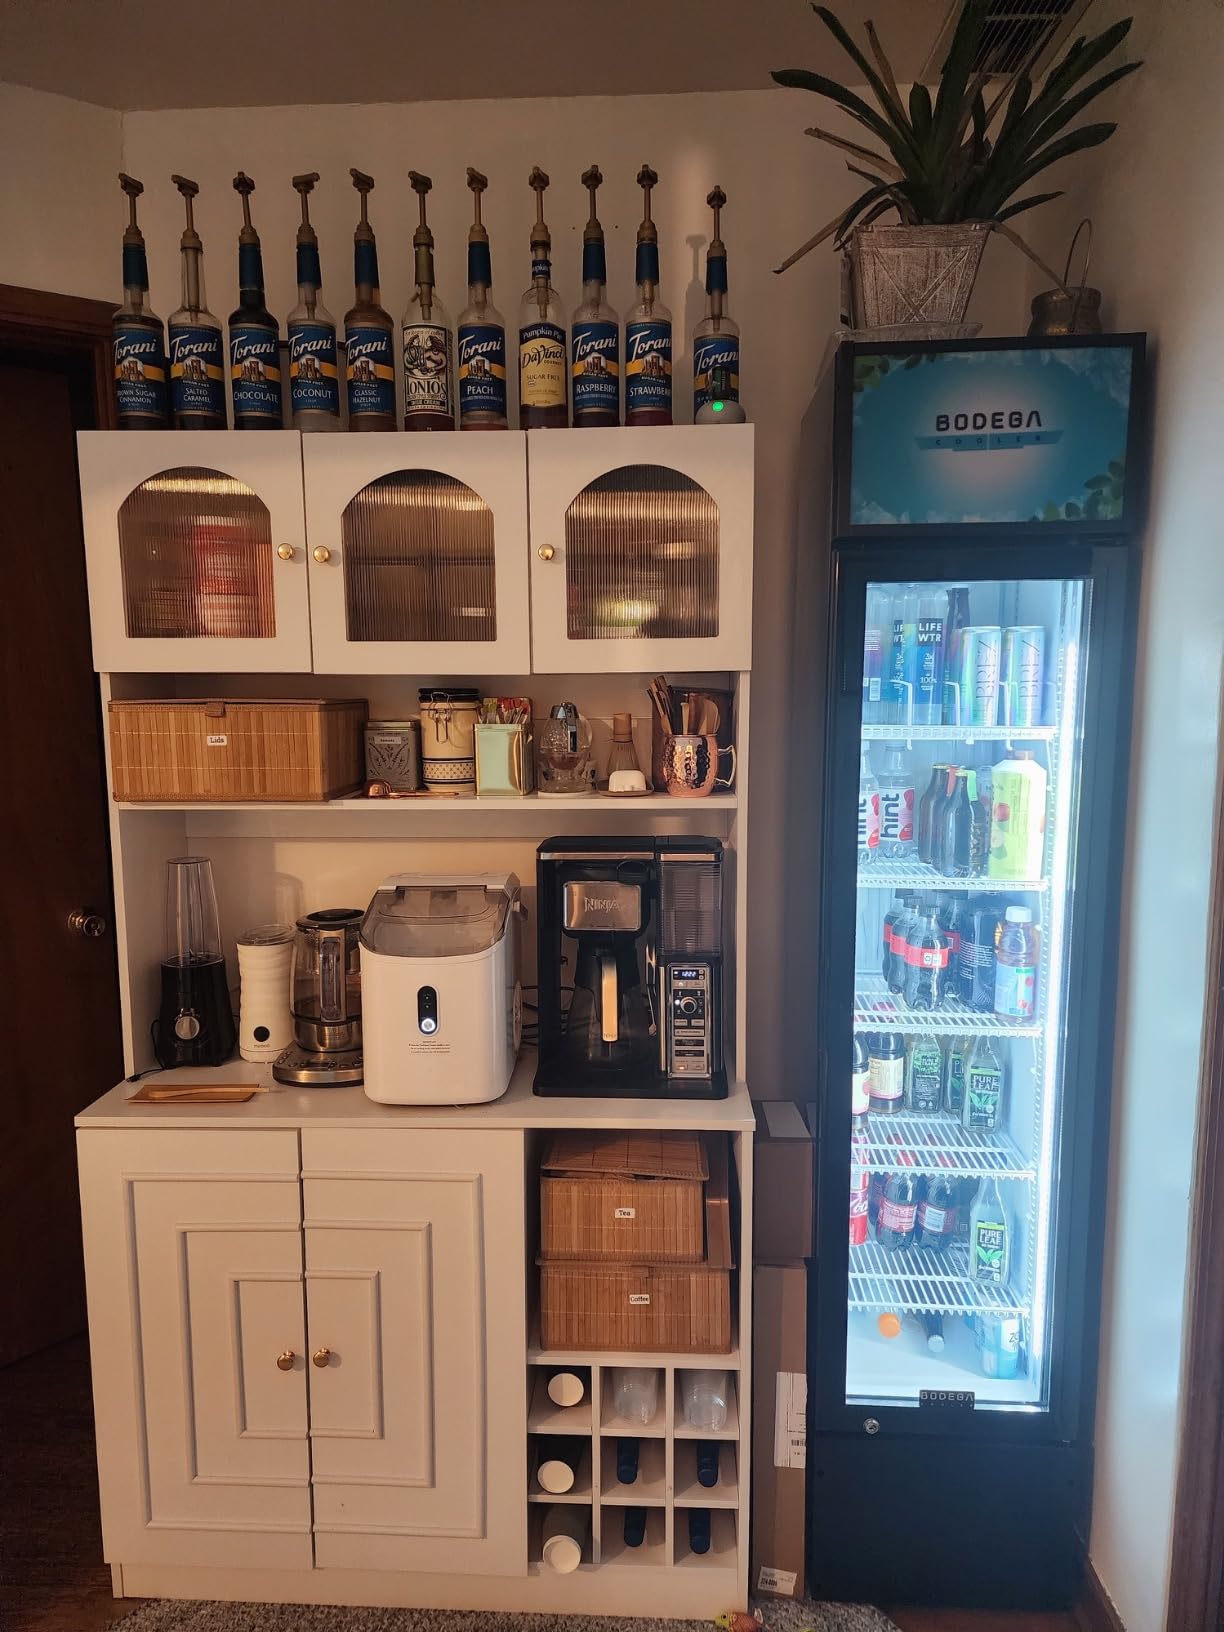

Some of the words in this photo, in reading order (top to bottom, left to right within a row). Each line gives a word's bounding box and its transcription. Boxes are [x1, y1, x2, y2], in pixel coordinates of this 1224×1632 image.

[524, 327, 552, 339] Pumpkin
[114, 336, 156, 366] Torani
[170, 335, 218, 366] Torani
[231, 336, 275, 365] Torani
[288, 333, 332, 364] Torani
[345, 336, 388, 366] Torani
[459, 335, 502, 366] Torani
[573, 331, 617, 364] Torani
[522, 345, 564, 368] DaVinci
[136, 388, 156, 398] SUGAR
[293, 388, 332, 399] COCONUT
[467, 386, 494, 394] PEACH
[576, 384, 616, 393] RASPBERRY
[234, 391, 279, 403] CHOCOLATE
[936, 410, 1042, 431] BODEGA
[918, 622, 942, 631] LIFE
[918, 634, 941, 642] WTR
[880, 792, 899, 839] hint
[973, 1076, 998, 1084] PURE
[980, 1229, 1002, 1238] PURE
[980, 1236, 1001, 1245] LEAF
[921, 1392, 974, 1401] BODEGA
